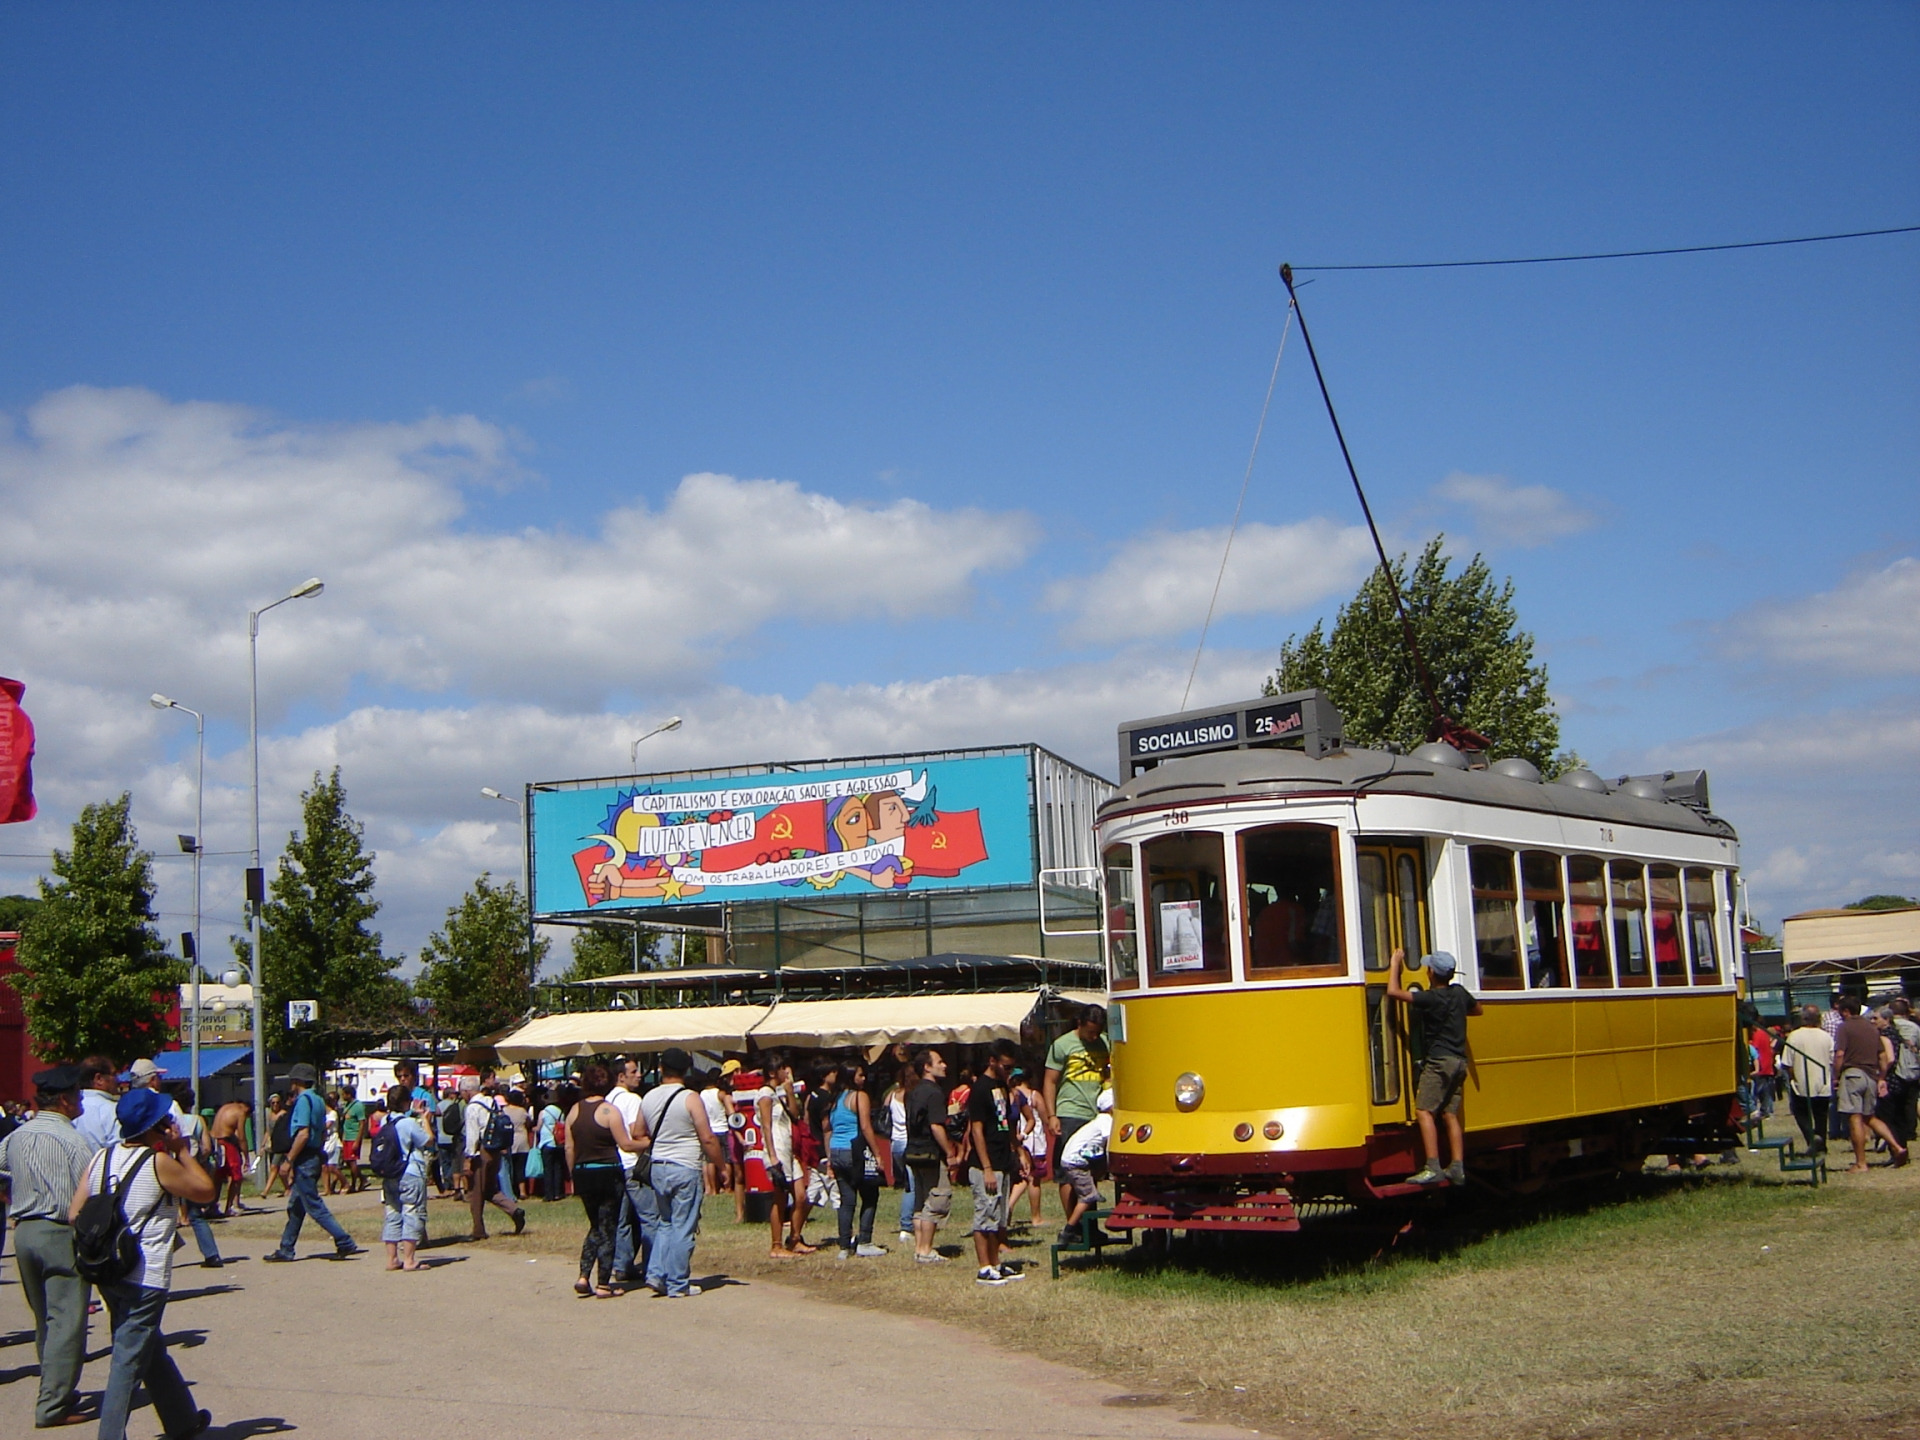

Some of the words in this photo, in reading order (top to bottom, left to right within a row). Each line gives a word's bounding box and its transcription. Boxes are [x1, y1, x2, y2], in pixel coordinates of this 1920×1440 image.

[1138, 724, 1234, 752] SOCIALISMO
[1255, 716, 1273, 733] 25
[1270, 712, 1301, 735] Abril
[642, 792, 717, 811] CAPITALISMO
[720, 790, 728, 808] É
[731, 787, 797, 807] EXPLORAÇÃO,
[799, 784, 831, 802] SAQUE
[835, 782, 842, 794] E
[846, 775, 898, 794] AGRESSÃO
[700, 816, 753, 848] VENCER
[1162, 810, 1189, 827] 738
[677, 873, 704, 884] COM
[709, 874, 722, 883] OS
[726, 858, 830, 883] TRABALHADORES
[837, 855, 845, 866] E
[850, 852, 858, 863] O
[863, 843, 895, 862] POVO
